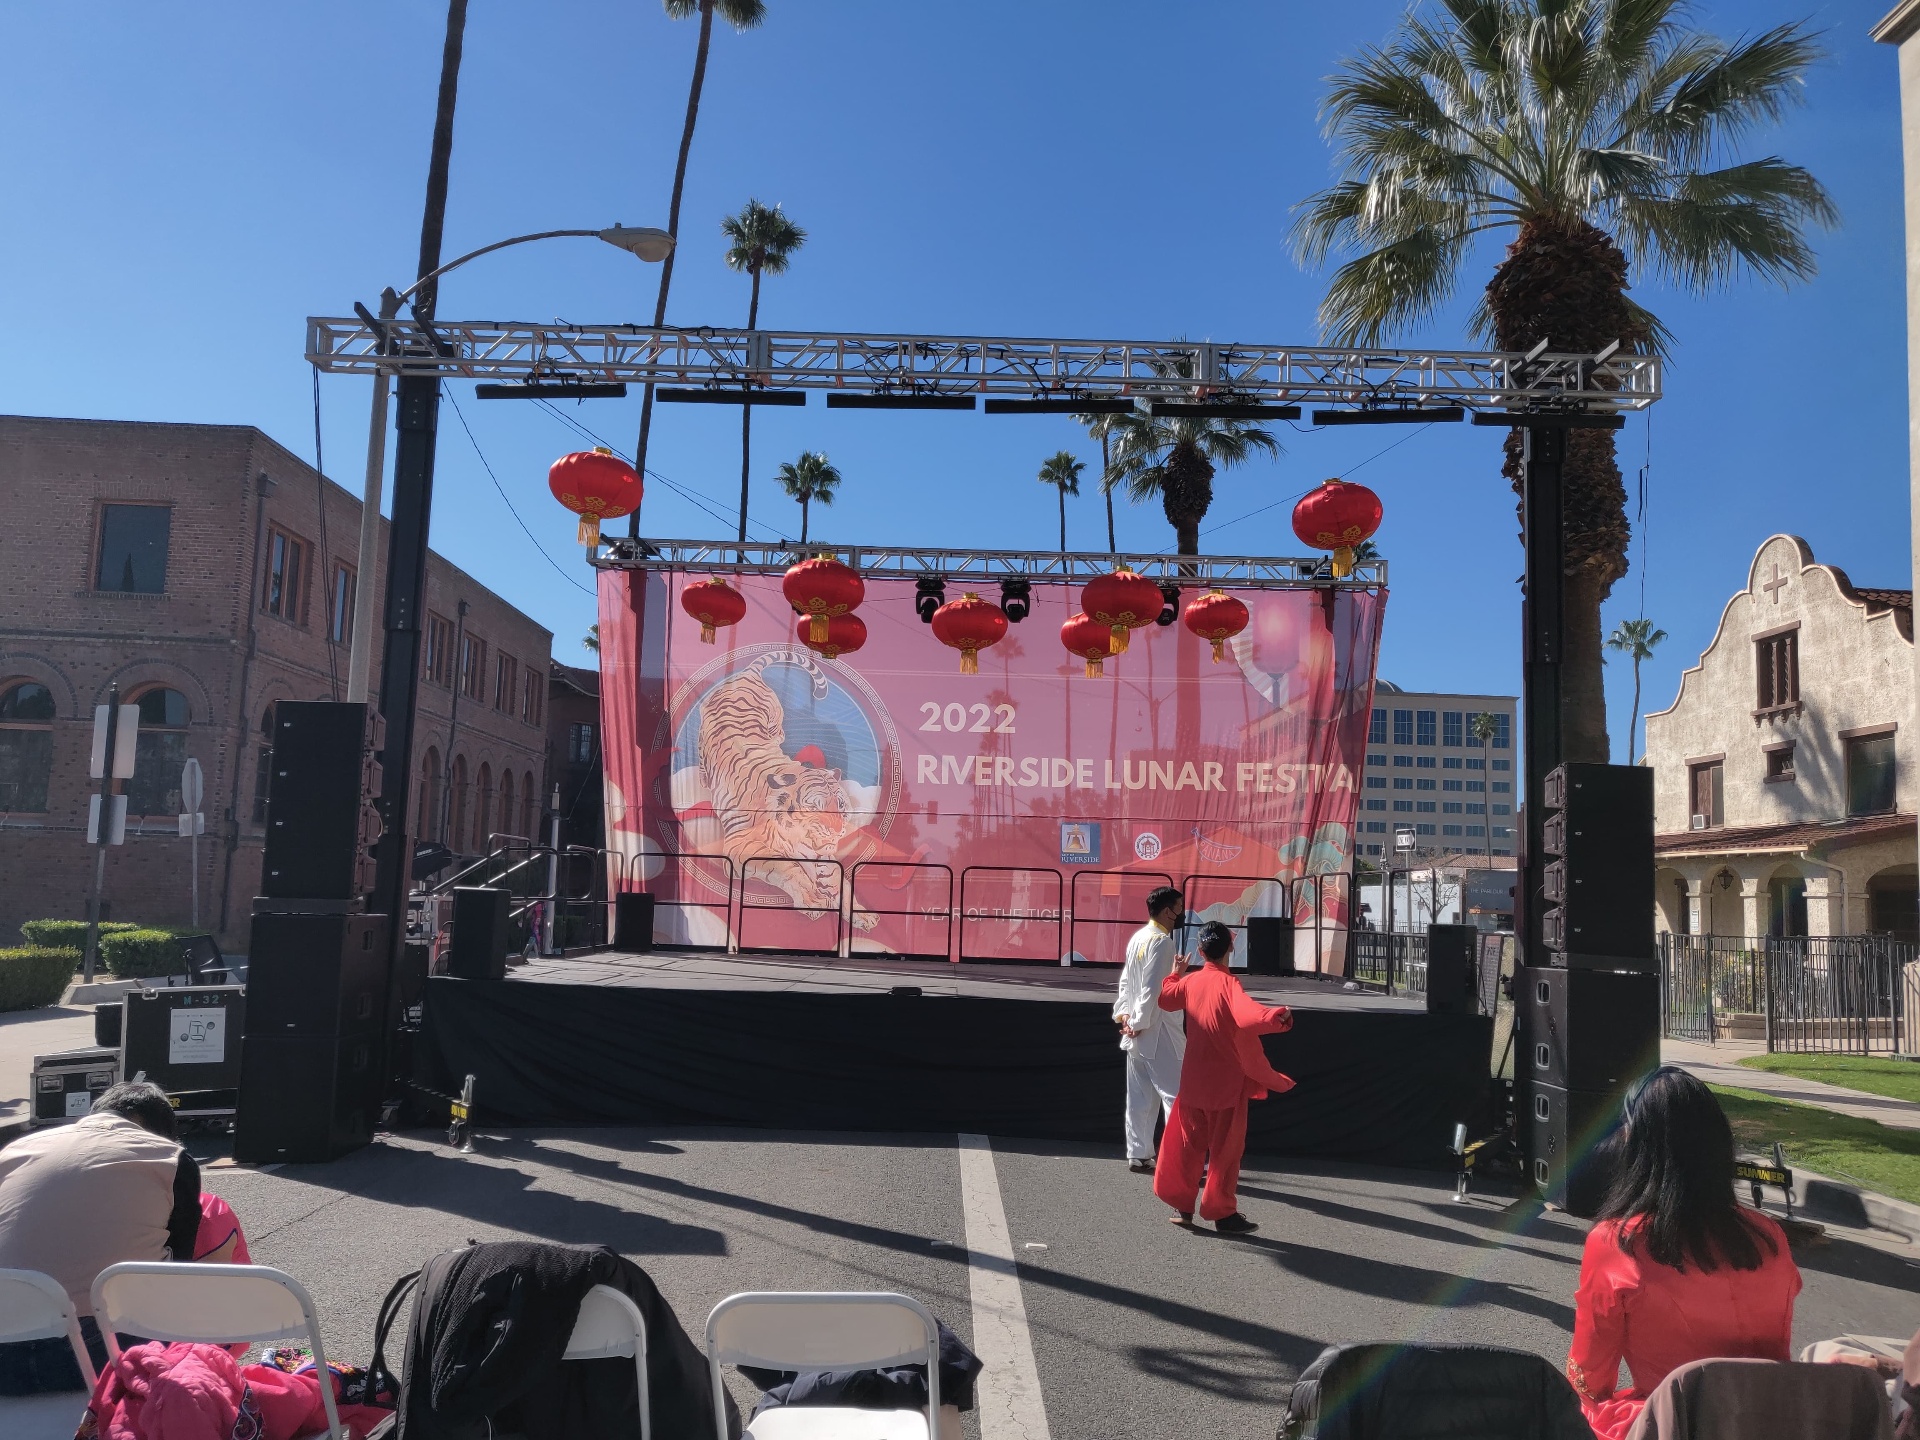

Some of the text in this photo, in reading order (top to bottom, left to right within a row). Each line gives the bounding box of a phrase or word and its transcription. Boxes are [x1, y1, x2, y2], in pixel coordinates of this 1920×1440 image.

[918, 701, 1016, 734] 2022
[917, 754, 1094, 789] RIVERSIDE
[1104, 759, 1228, 792] LUNAR
[1061, 856, 1100, 864] RIVERSIDE
[921, 907, 1072, 924] YEAR OF THE TIGER
